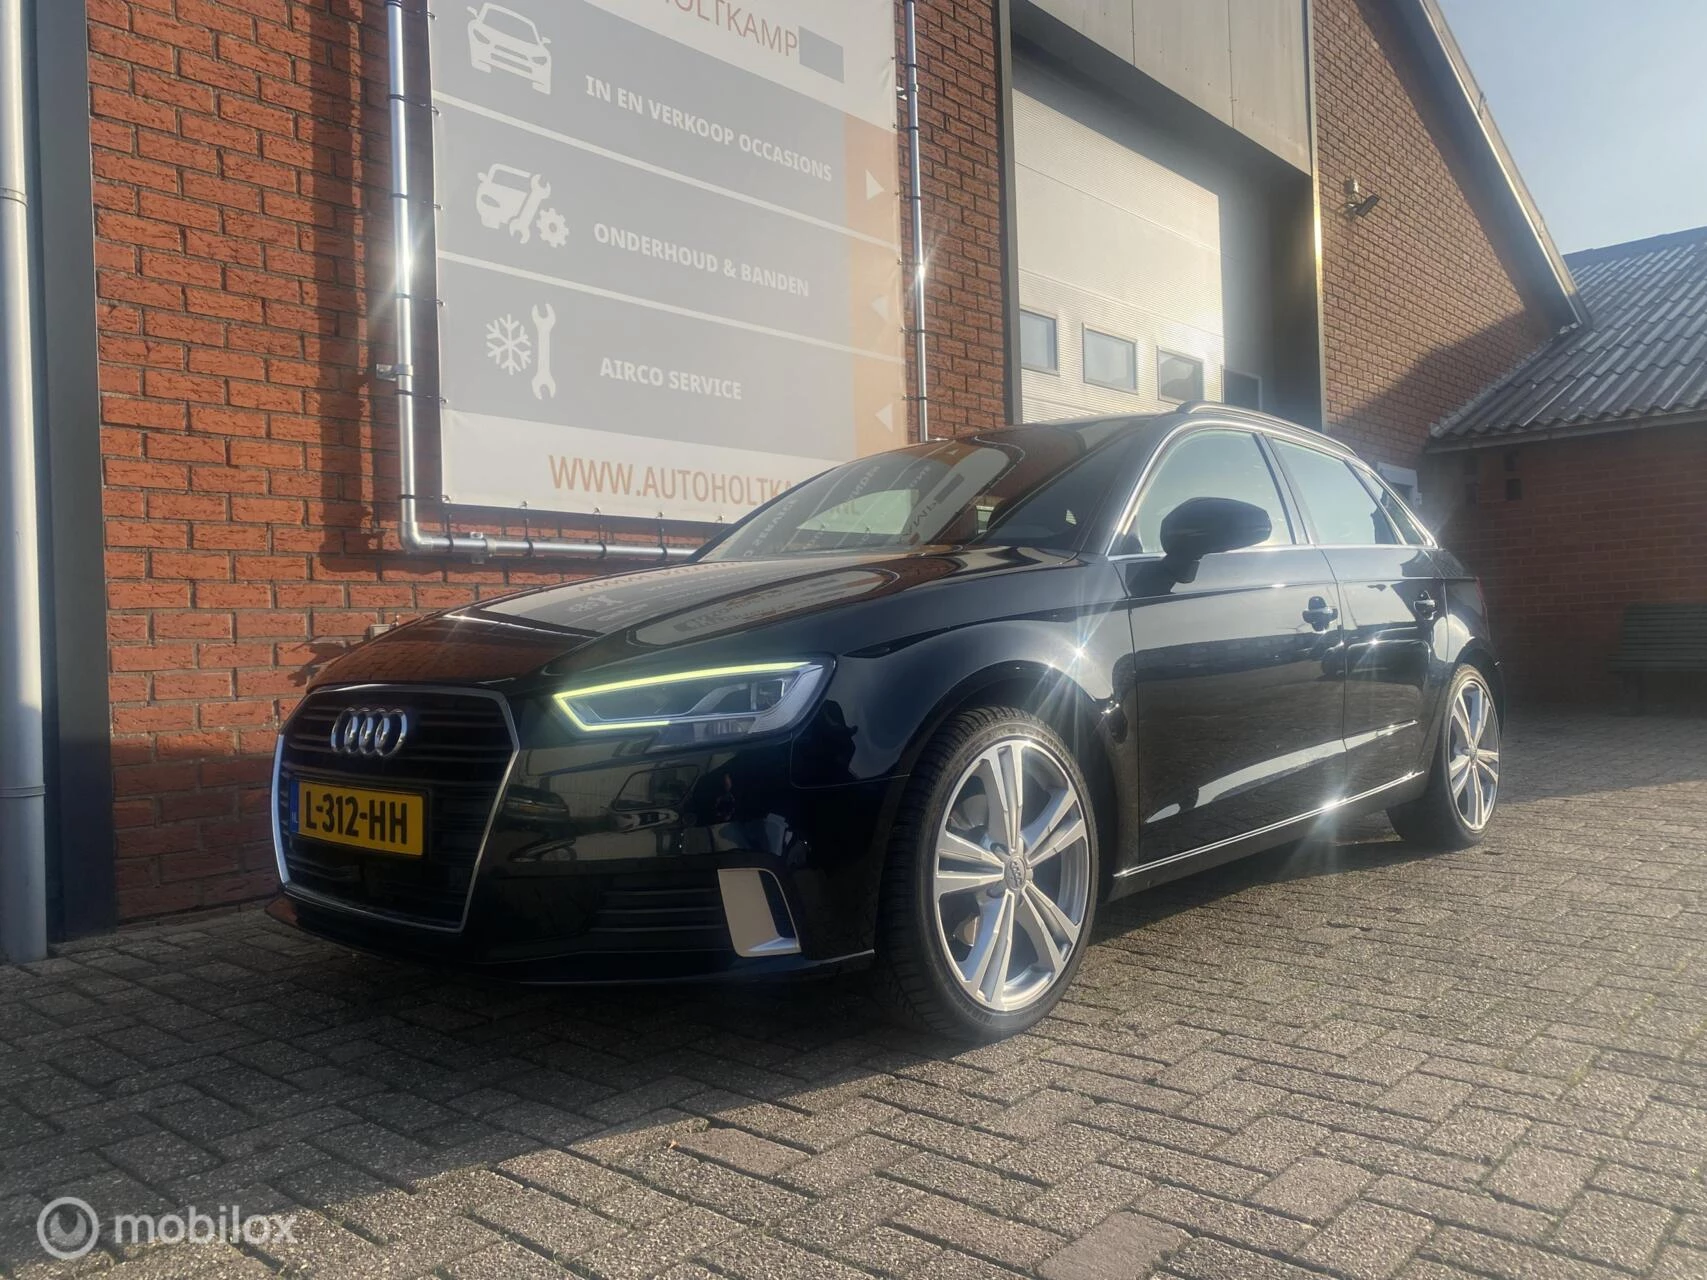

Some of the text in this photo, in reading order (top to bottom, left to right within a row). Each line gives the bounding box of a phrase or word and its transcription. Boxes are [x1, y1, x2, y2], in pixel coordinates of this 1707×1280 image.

[665, 0, 798, 56] LTKAMP
[585, 74, 833, 183] IN EN VERKOOP OCCASIONS
[594, 222, 809, 298] ONDERHOUD & BANDEN
[600, 357, 742, 400] AIRCO SERVICE
[549, 455, 798, 506] WWW.AUTOHOLTK
[305, 790, 408, 845] L-312-HH
